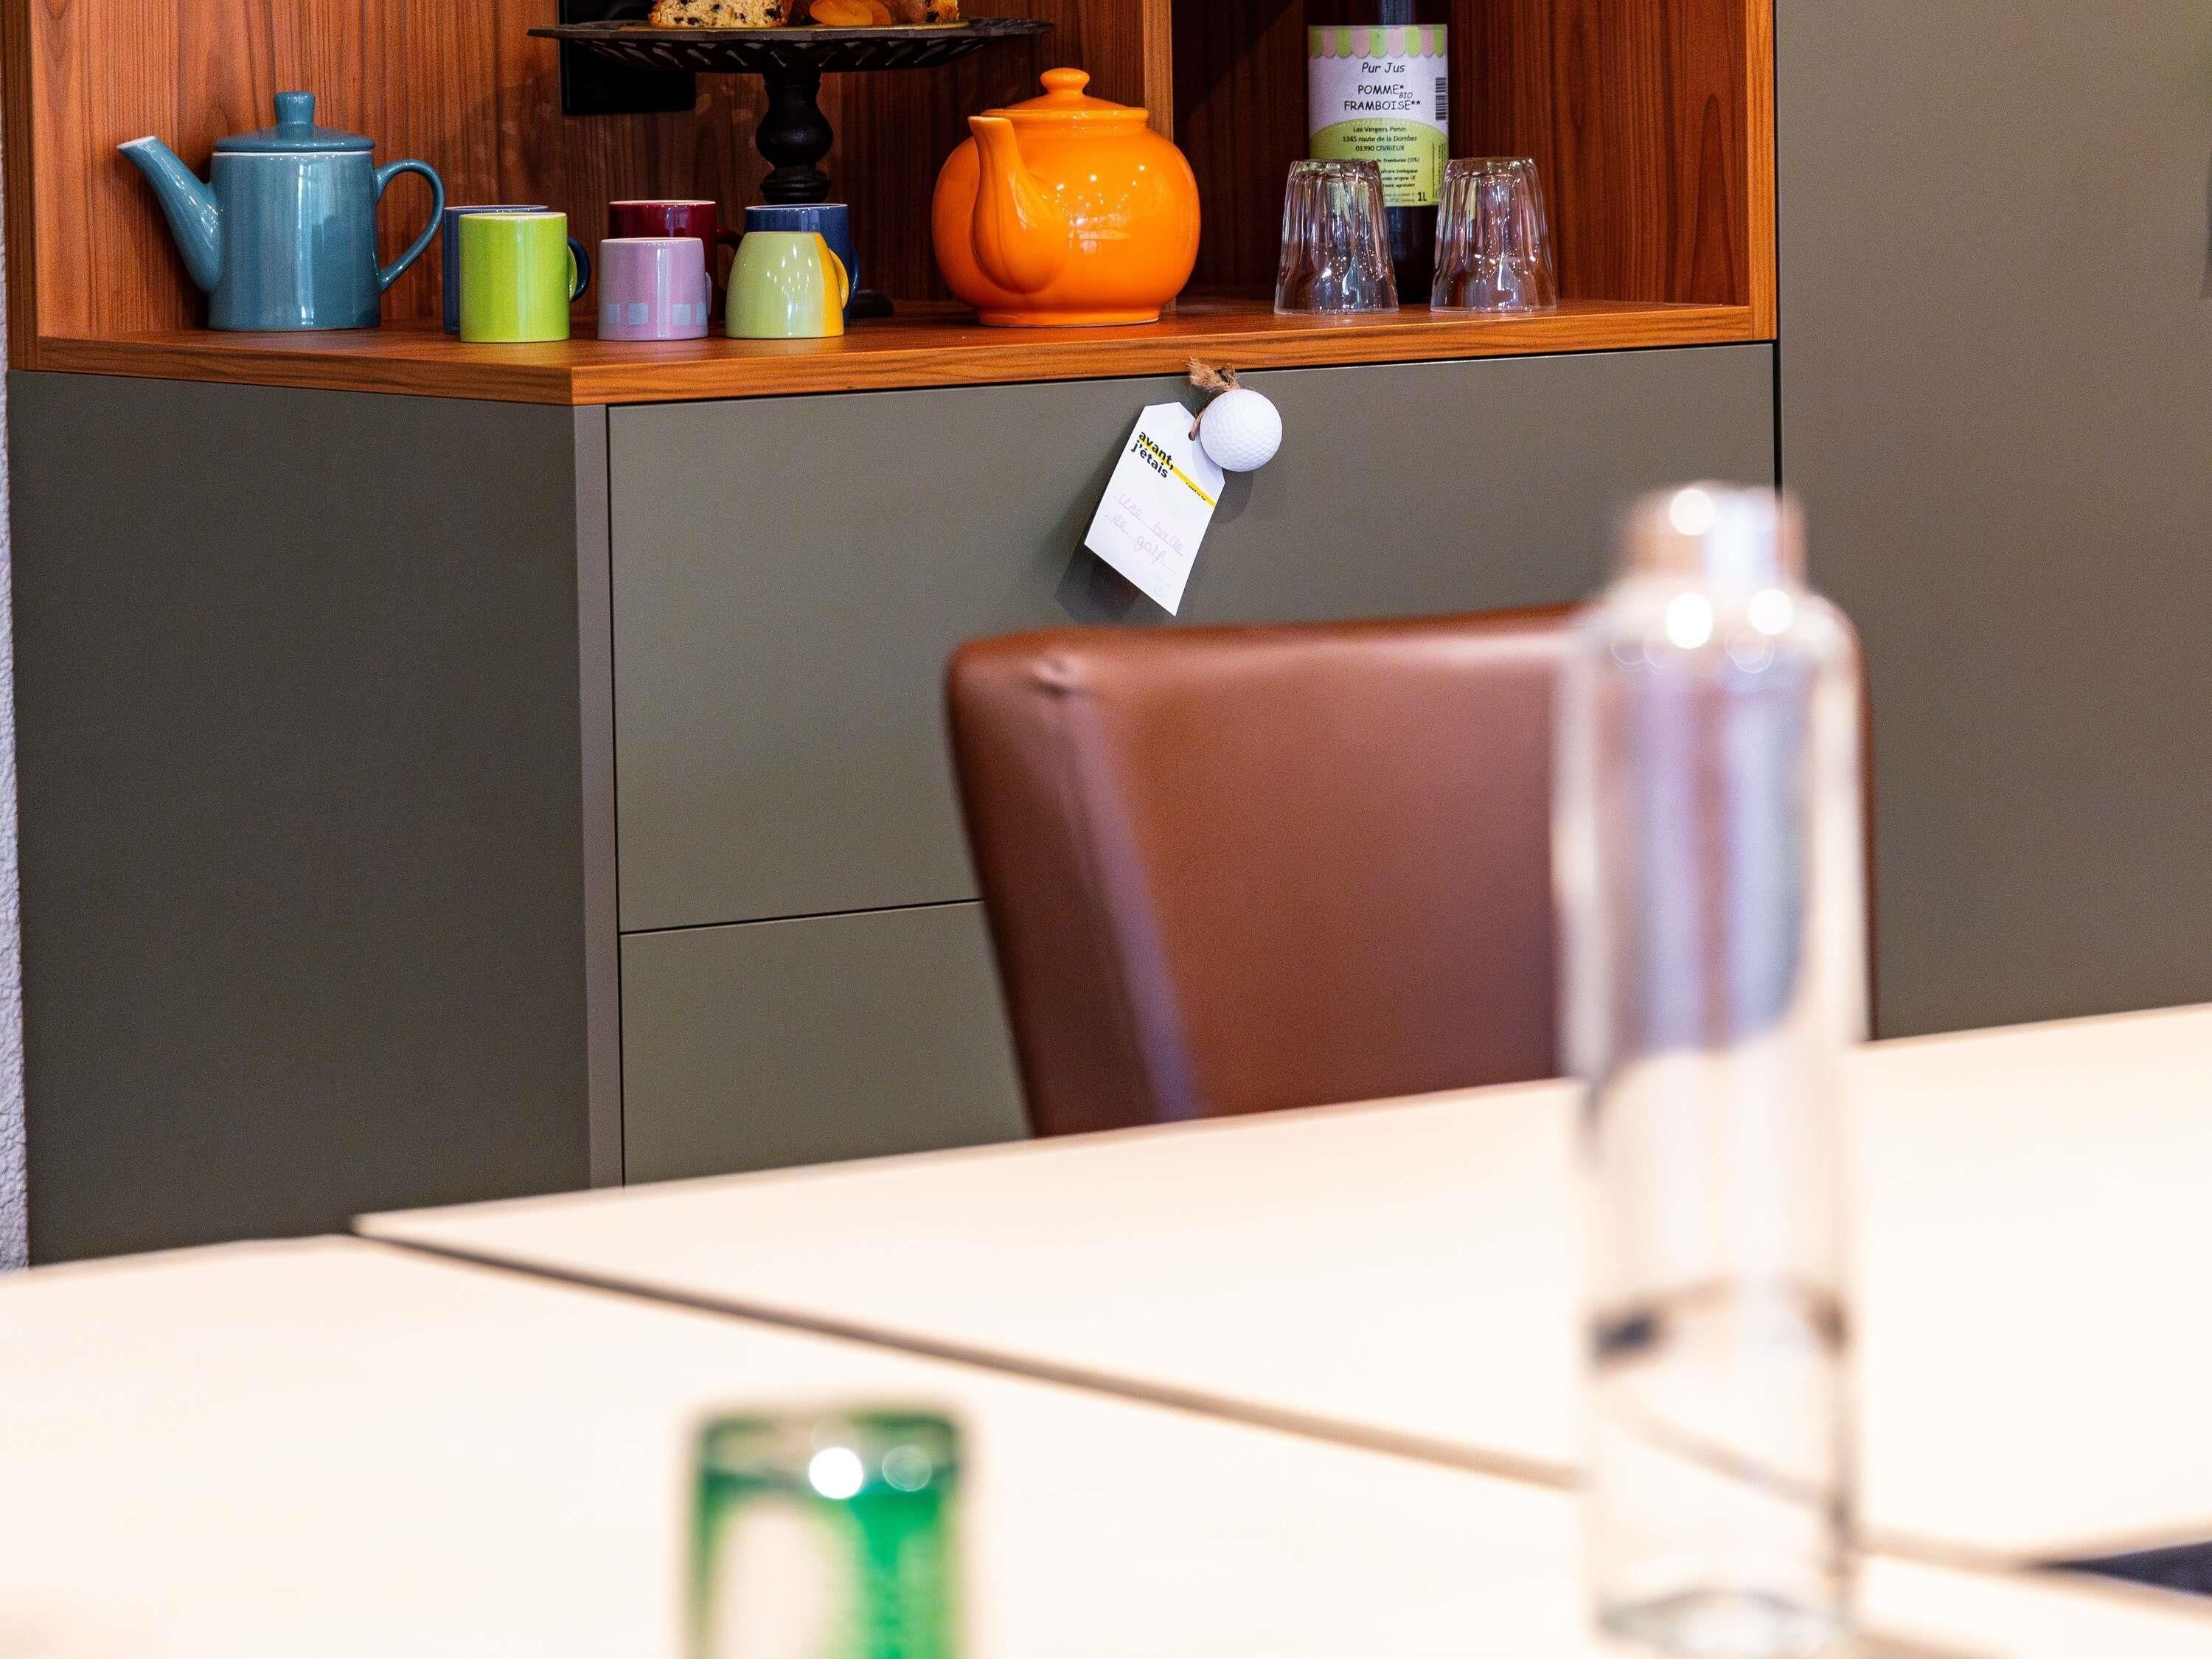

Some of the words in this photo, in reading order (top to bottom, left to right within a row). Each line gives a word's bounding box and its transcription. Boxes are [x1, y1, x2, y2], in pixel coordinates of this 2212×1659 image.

[1361, 62, 1381, 73] Pur
[1384, 62, 1405, 73] Jus
[1417, 192, 1427, 202] 1L
[1130, 439, 1169, 479] j'étais
[1138, 431, 1175, 470] avant,
